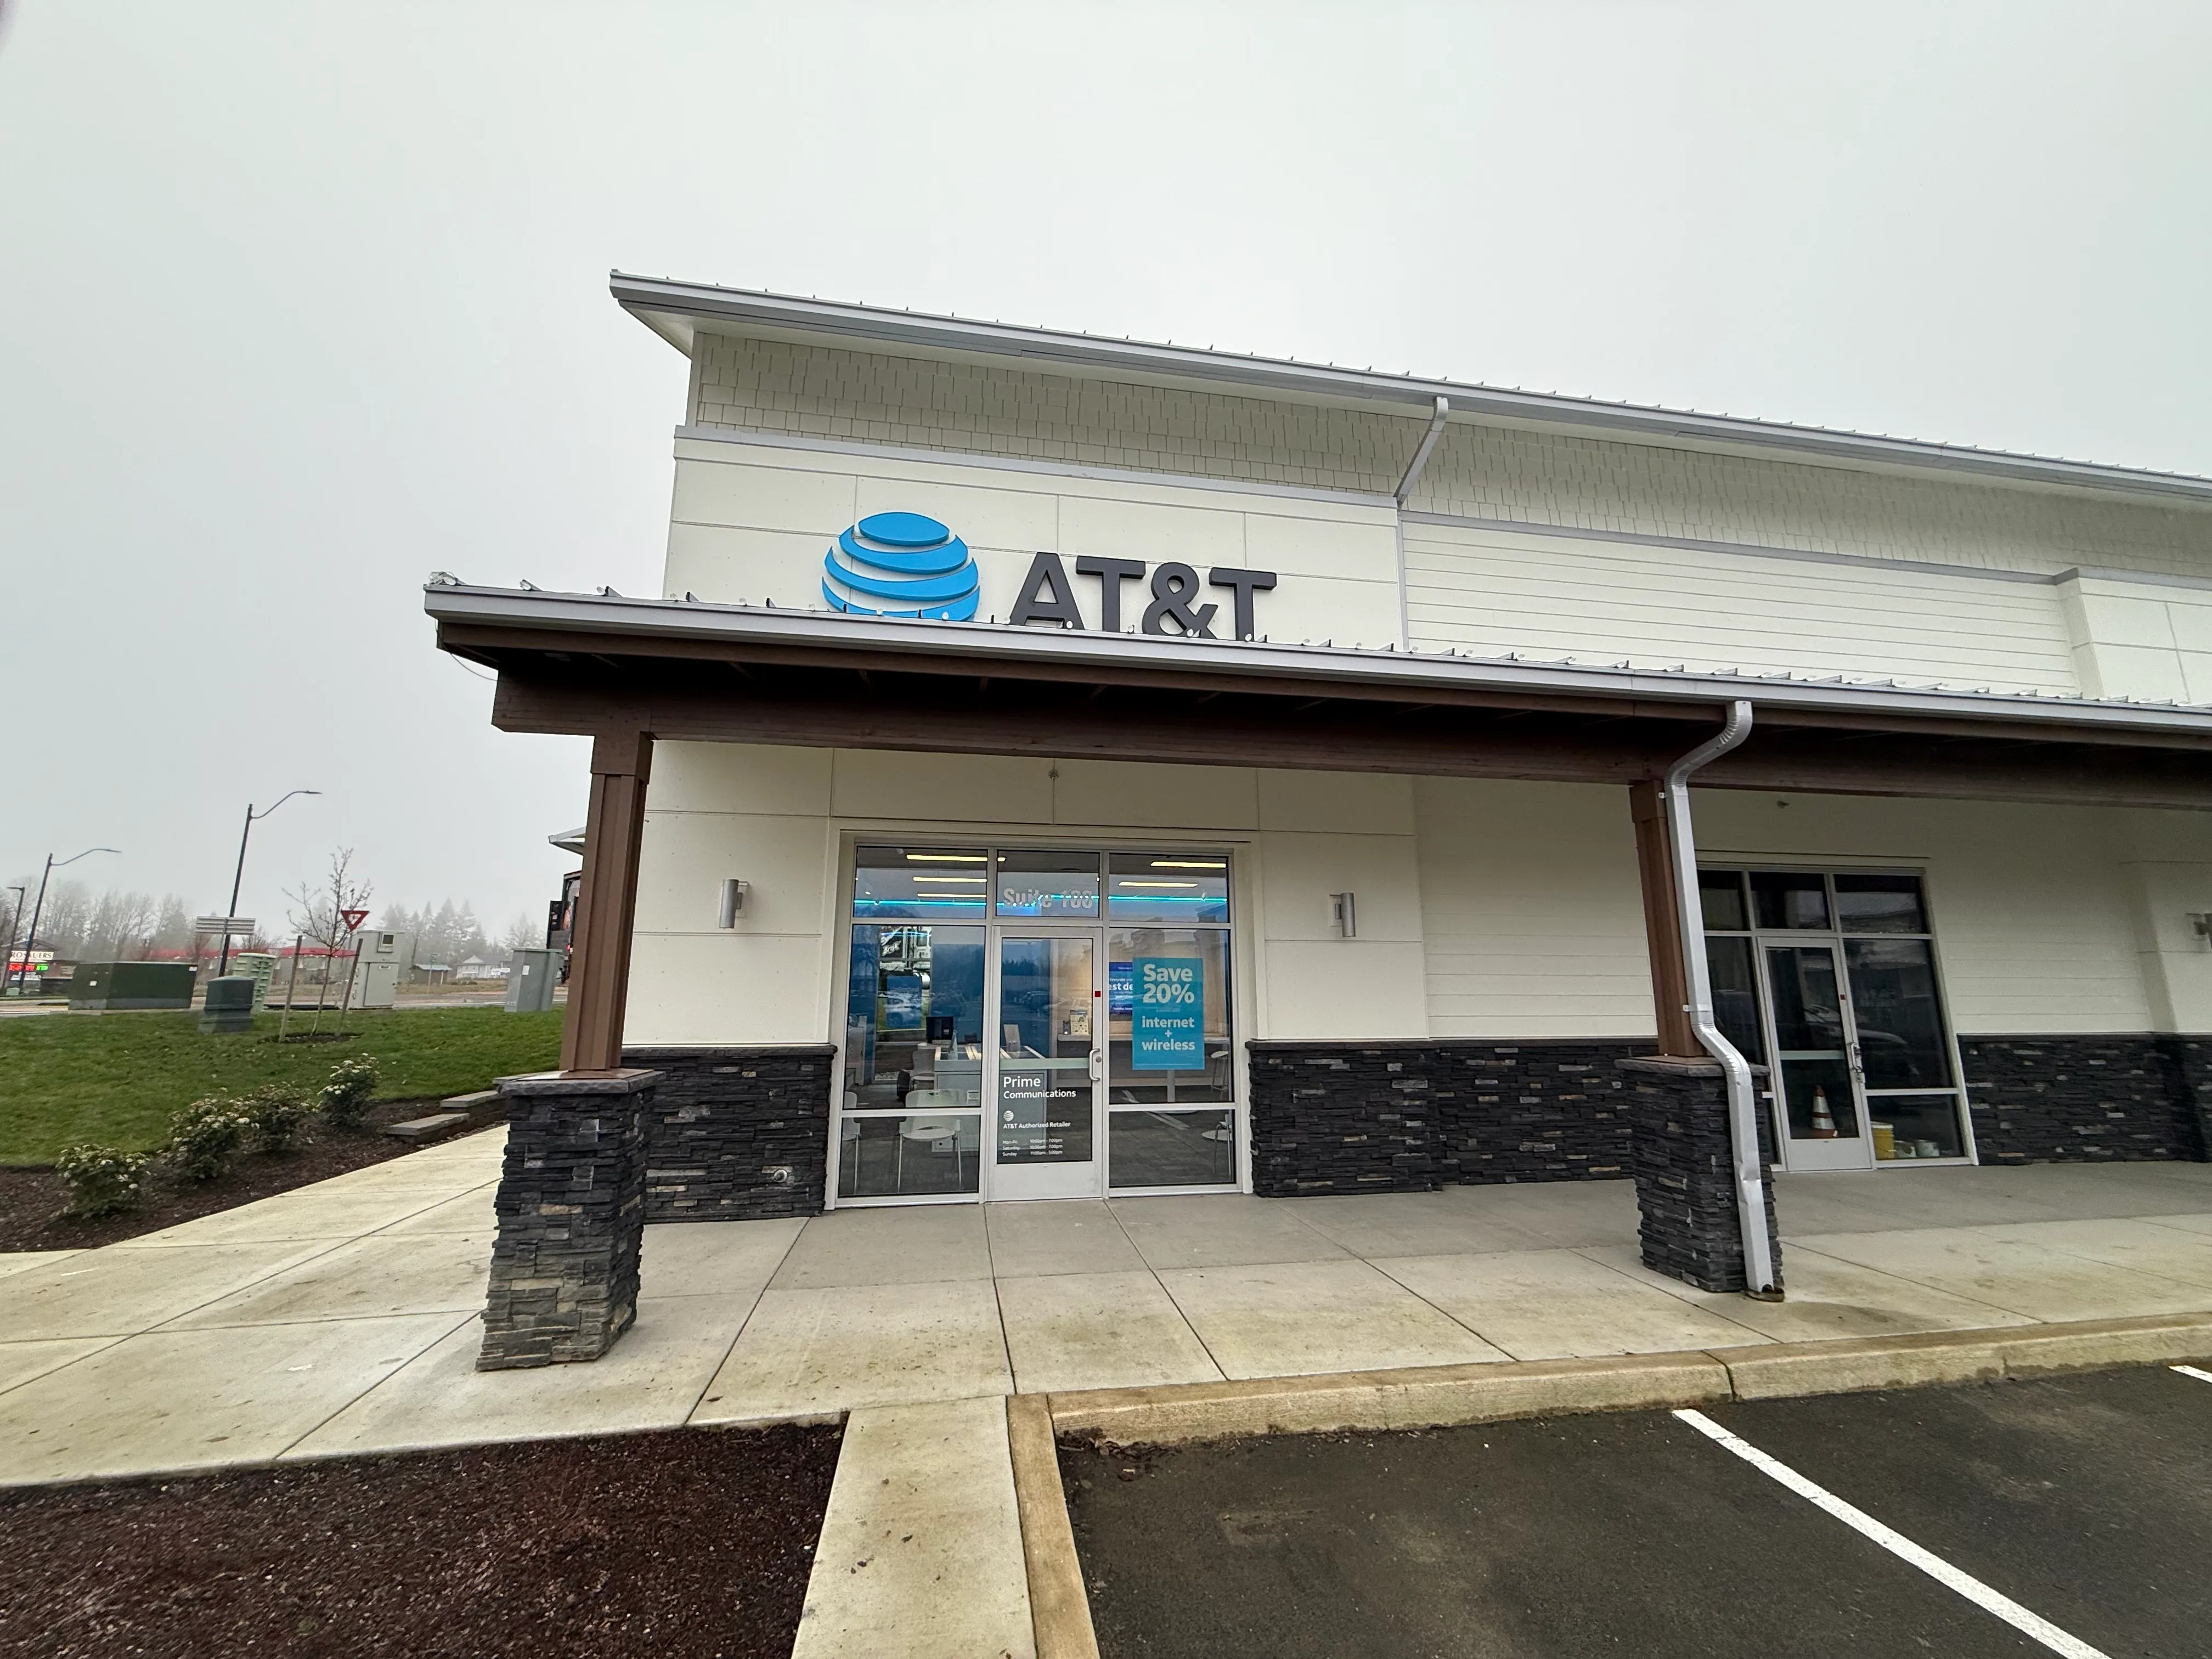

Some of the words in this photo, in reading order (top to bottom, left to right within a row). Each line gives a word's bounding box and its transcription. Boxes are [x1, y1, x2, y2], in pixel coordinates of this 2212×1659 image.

[1009, 552, 1277, 642] AT&T
[1003, 888, 1052, 908] Suite
[1143, 964, 1193, 982] Save
[1143, 983, 1195, 1004] 20%
[1142, 1015, 1195, 1028] internet
[1142, 1039, 1195, 1051] wireless
[1003, 1076, 1041, 1088] Prime
[1003, 1089, 1076, 1099] Communications
